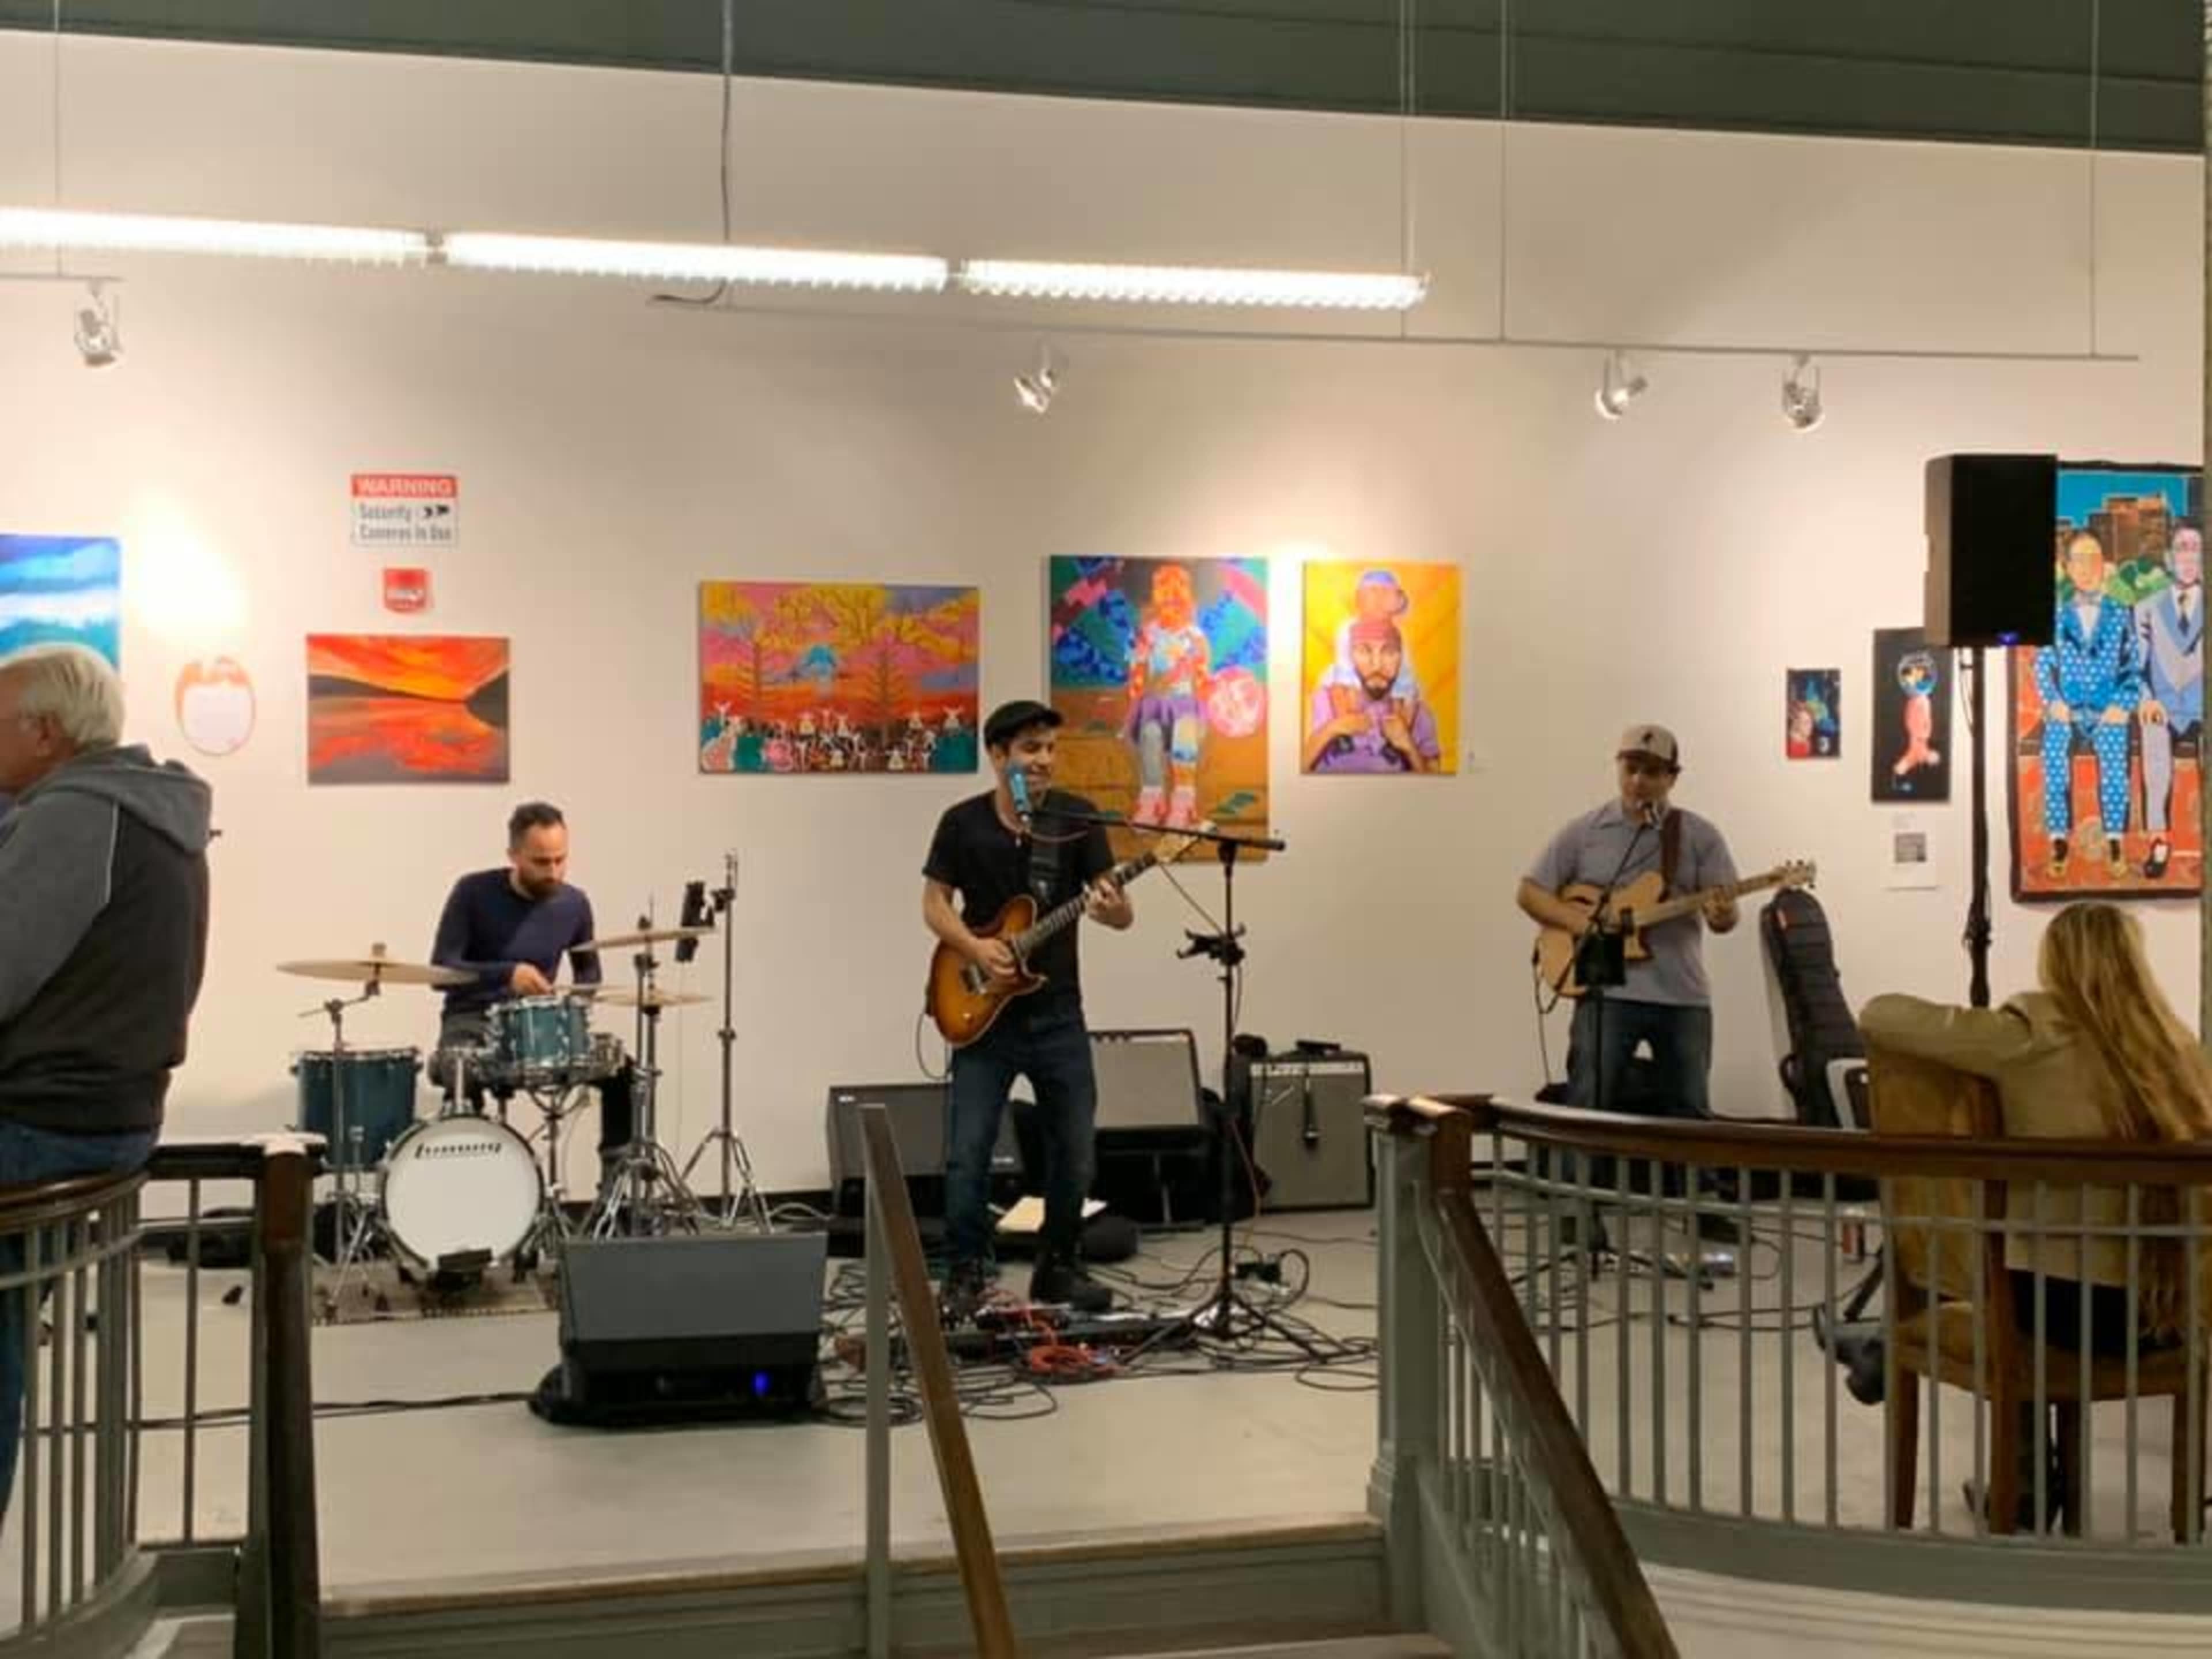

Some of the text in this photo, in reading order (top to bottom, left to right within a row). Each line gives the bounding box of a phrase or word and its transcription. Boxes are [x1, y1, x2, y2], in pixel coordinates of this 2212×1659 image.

[356, 478, 451, 494] WARNING
[359, 503, 412, 522] Security
[359, 524, 412, 539] Cameras
